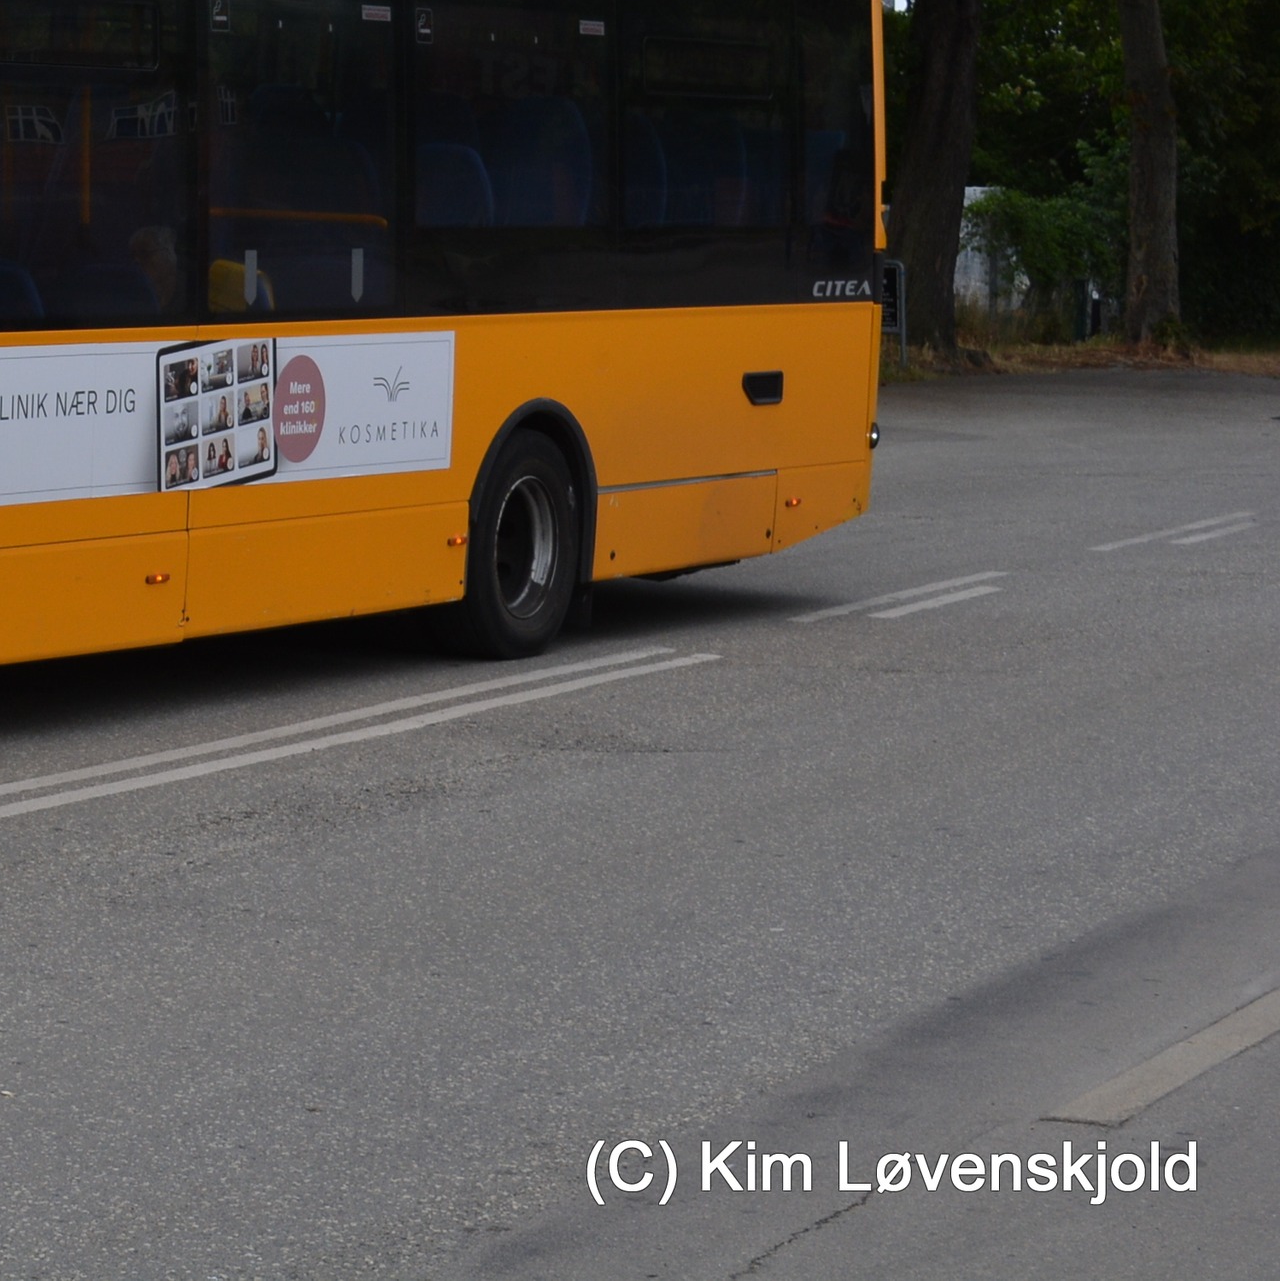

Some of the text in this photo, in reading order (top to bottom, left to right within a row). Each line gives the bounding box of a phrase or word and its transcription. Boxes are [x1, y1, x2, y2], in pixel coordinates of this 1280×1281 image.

[812, 280, 871, 296] CITEA
[289, 381, 311, 395] Mere
[55, 390, 98, 417] NÆR
[105, 388, 136, 414] DIG
[283, 400, 316, 415] end 160
[279, 420, 318, 436] klinikker
[338, 420, 439, 445] KOSMETIKA
